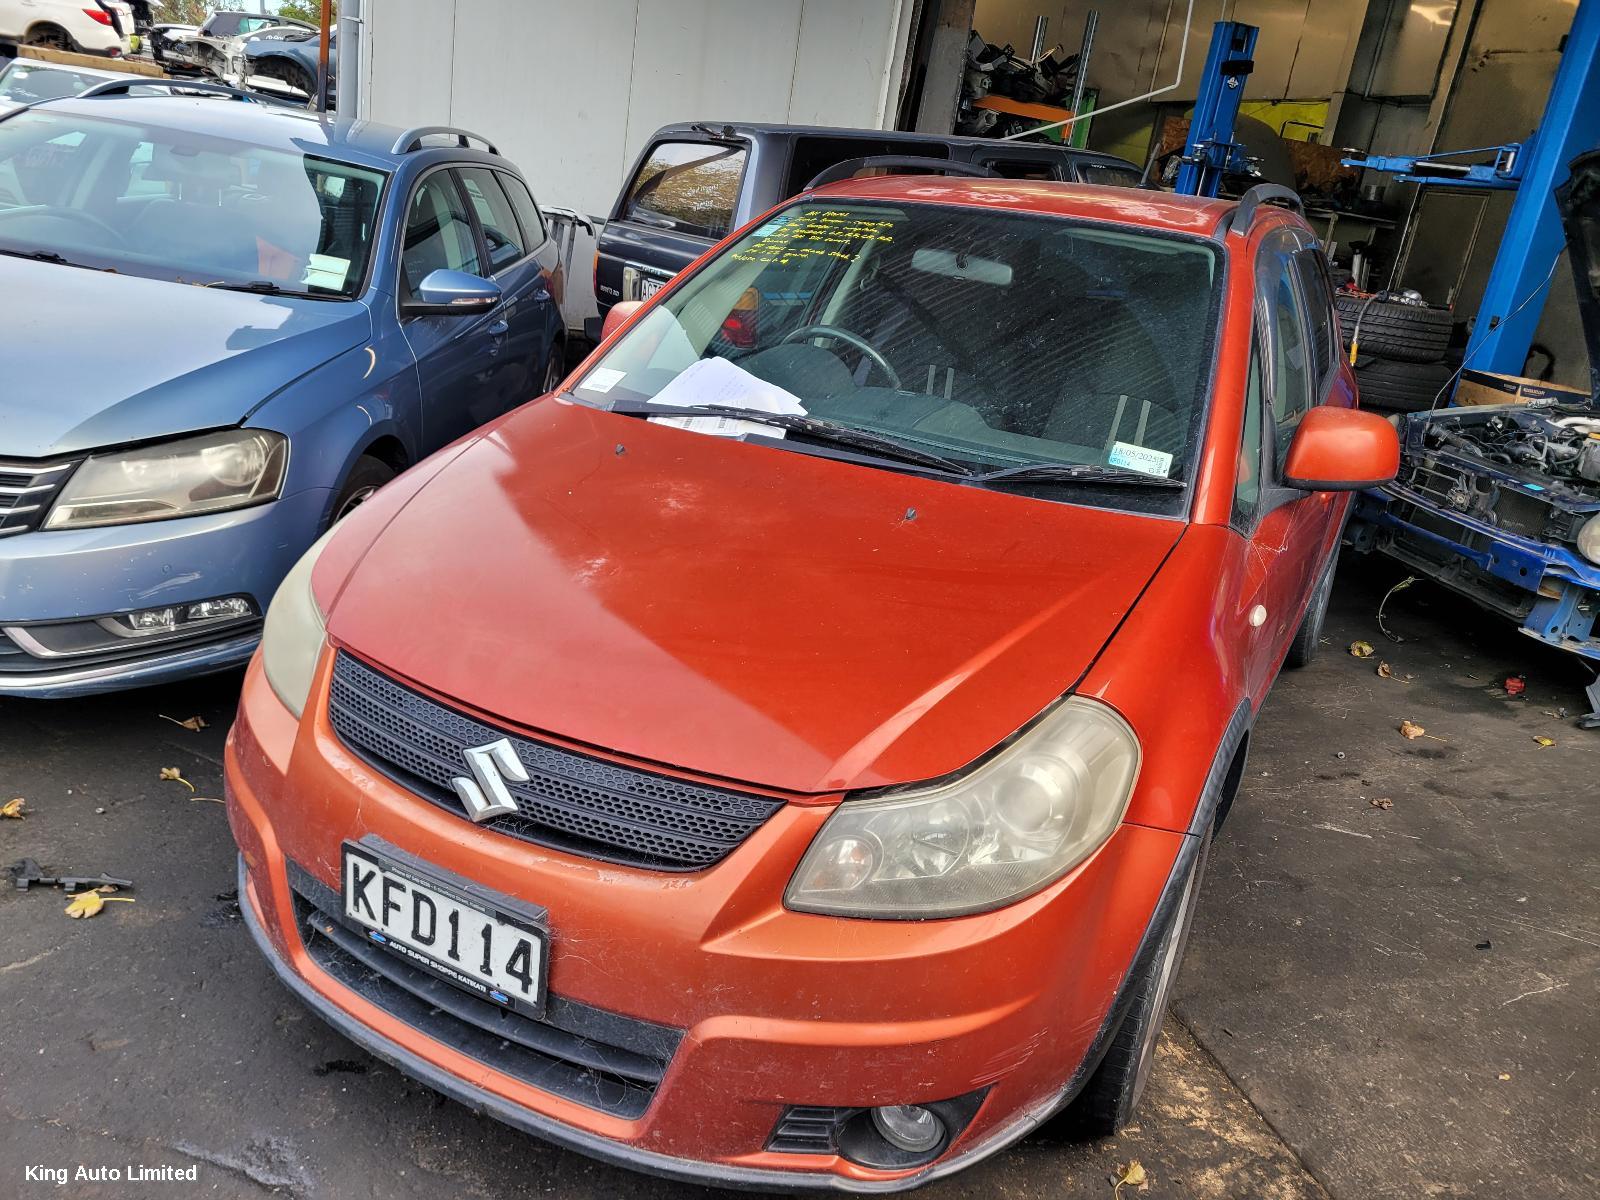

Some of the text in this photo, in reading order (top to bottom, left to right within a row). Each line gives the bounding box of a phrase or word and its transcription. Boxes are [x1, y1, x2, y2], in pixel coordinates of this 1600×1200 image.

[352, 862, 533, 994] KFD114
[389, 941, 406, 954] AUTO
[407, 949, 430, 965] SUPER
